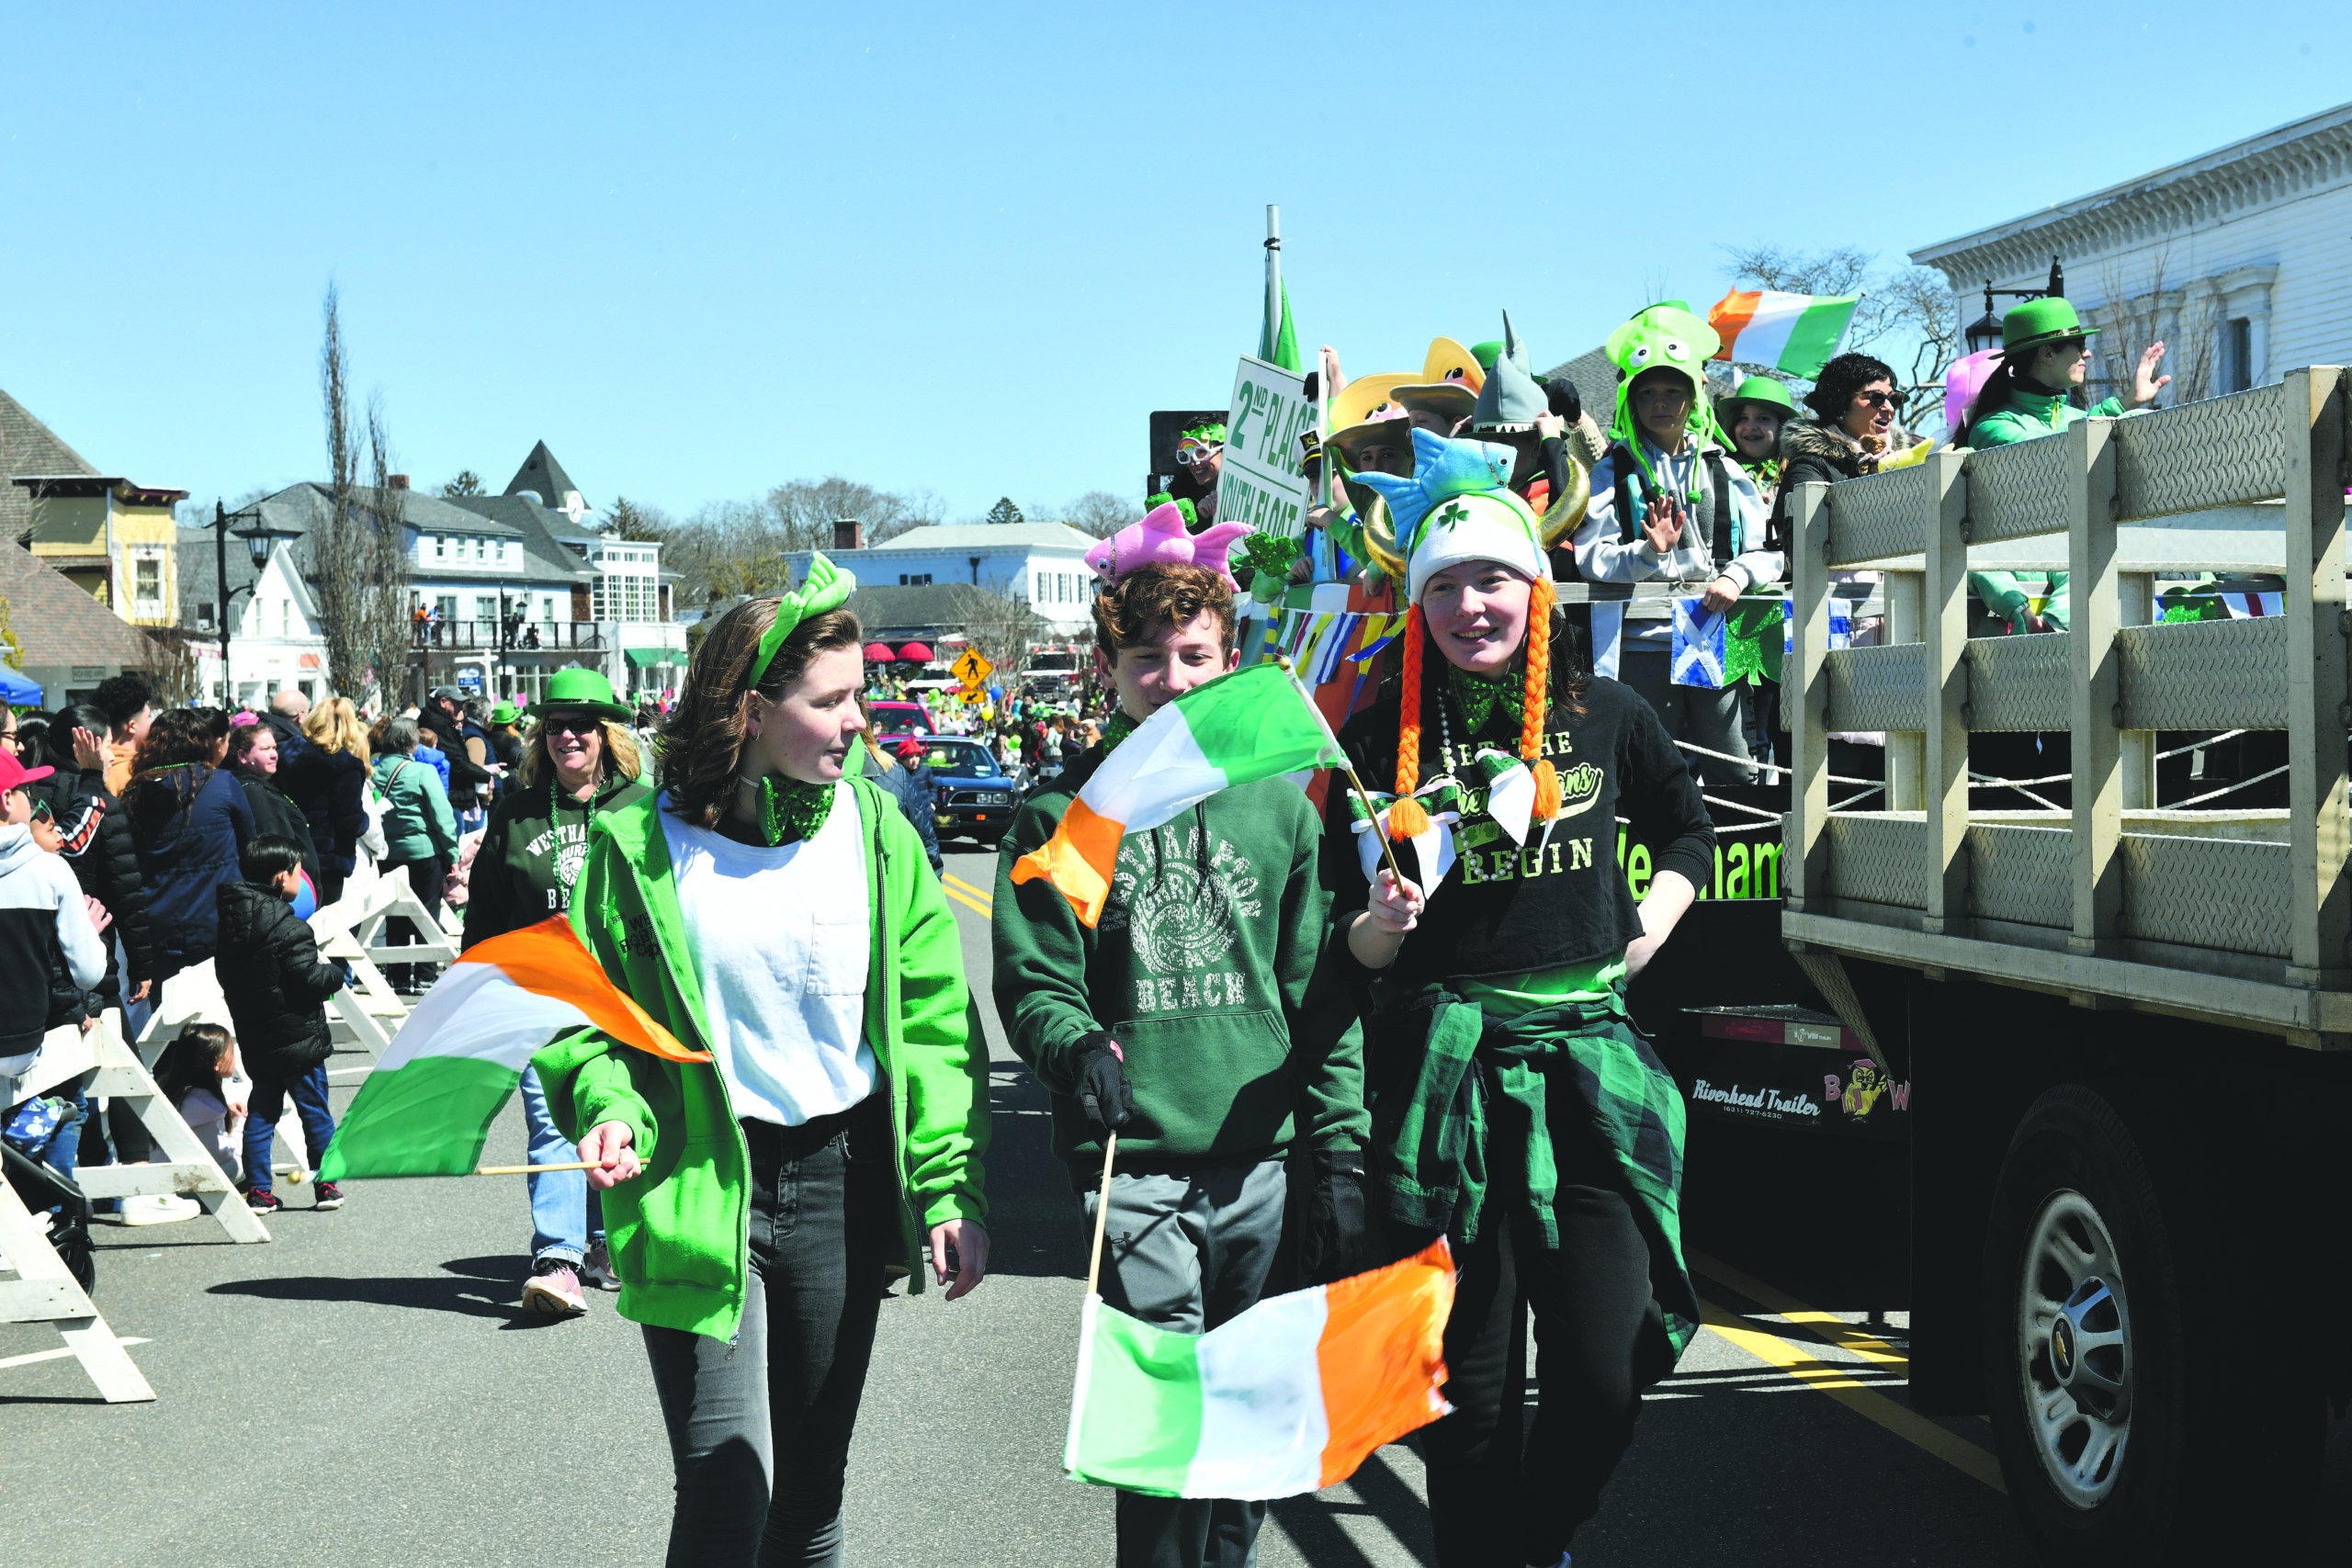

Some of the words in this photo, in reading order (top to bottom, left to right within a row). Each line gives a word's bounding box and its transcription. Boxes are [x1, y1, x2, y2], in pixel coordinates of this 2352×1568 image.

[1230, 380, 1269, 450] 2ND
[1218, 471, 1256, 539] YOUTH
[1460, 838, 1593, 885] BEGIN
[1136, 970, 1247, 1013] BEACH
[1692, 1078, 1765, 1110] Riverhead
[1768, 1089, 1821, 1117] Trailer
